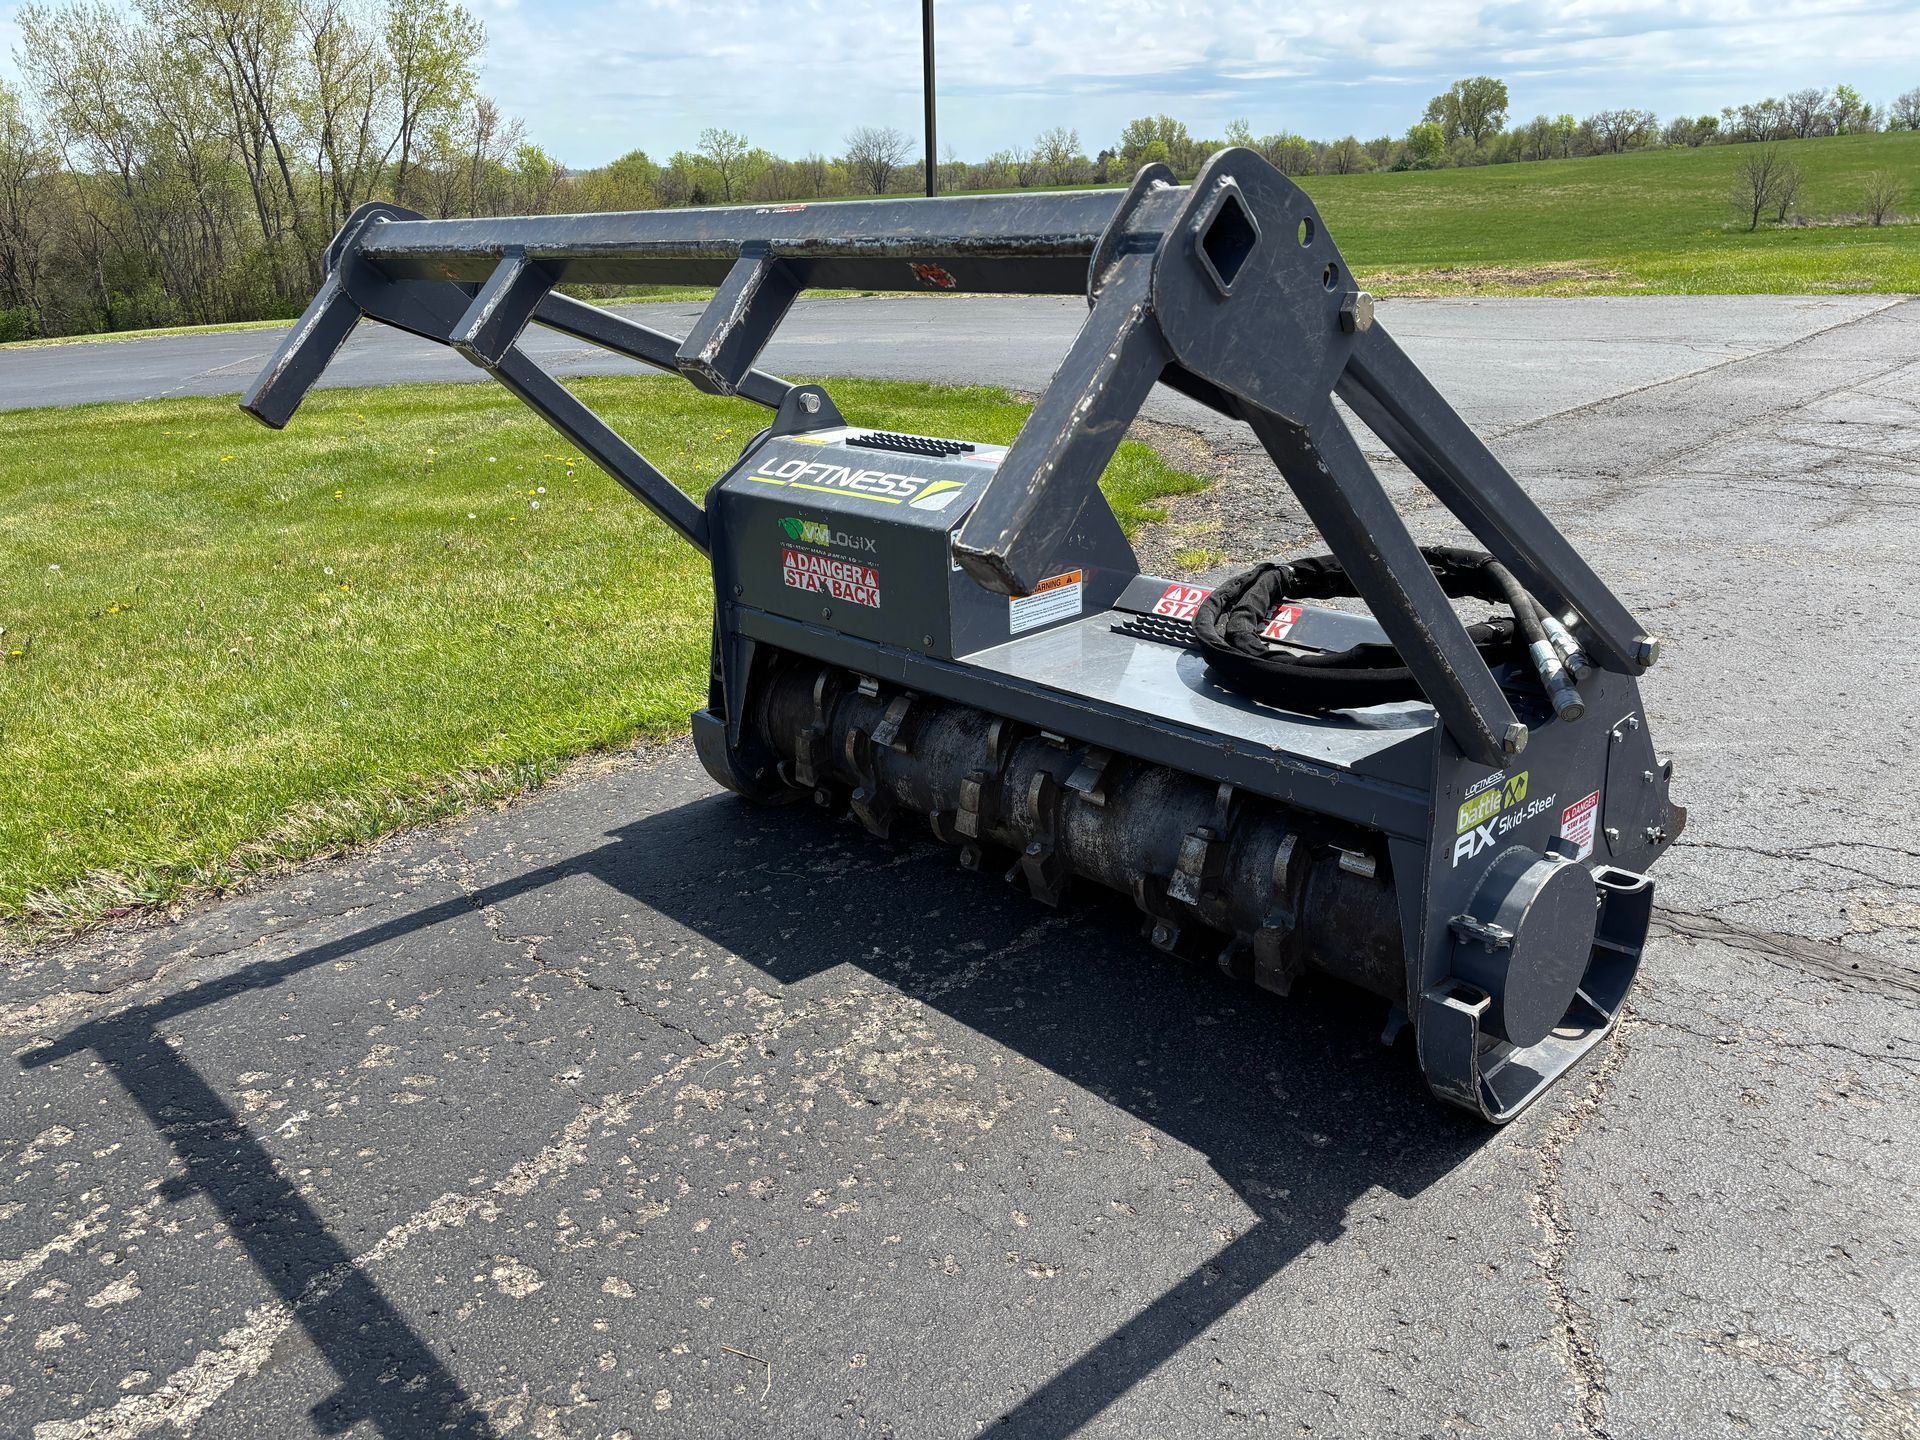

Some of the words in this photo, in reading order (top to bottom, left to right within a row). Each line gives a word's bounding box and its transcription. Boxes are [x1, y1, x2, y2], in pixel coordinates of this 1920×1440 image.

[757, 457, 929, 497] LOFTNESS
[797, 553, 863, 585] DANGER
[832, 580, 877, 607] BACK
[1033, 578, 1062, 592] ARNING
[1157, 601, 1199, 619] STA
[1465, 769, 1504, 797] LOFTNESS
[1458, 791, 1503, 831] battle
[1572, 795, 1597, 818] DANGER
[1452, 815, 1499, 868] AX
[1498, 793, 1557, 836] Skid-Steer
